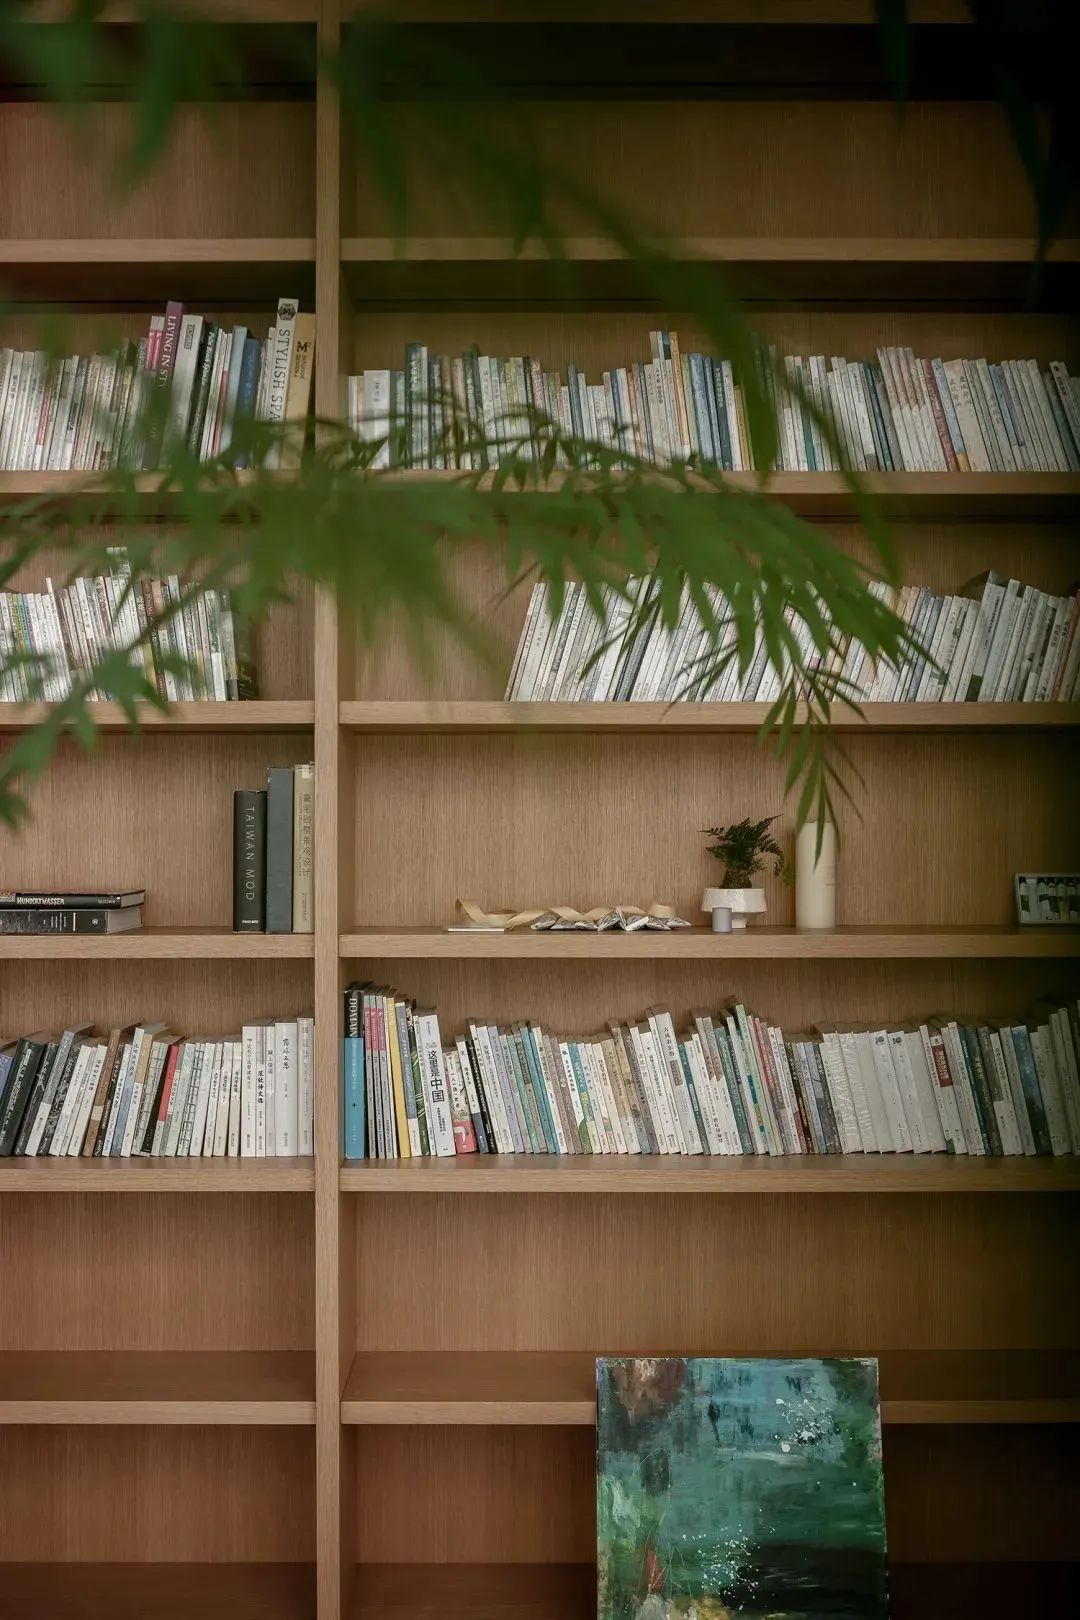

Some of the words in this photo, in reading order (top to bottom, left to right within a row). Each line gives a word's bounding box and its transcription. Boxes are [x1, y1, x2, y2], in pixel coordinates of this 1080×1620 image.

[163, 315, 177, 352] LIVING
[161, 354, 171, 367] IN
[272, 329, 290, 388] STYLISH
[245, 805, 255, 860] TAIWAN
[245, 870, 255, 901] MOD
[349, 998, 358, 1038] DOMAIN
[427, 1050, 445, 1104] 这里是中国
